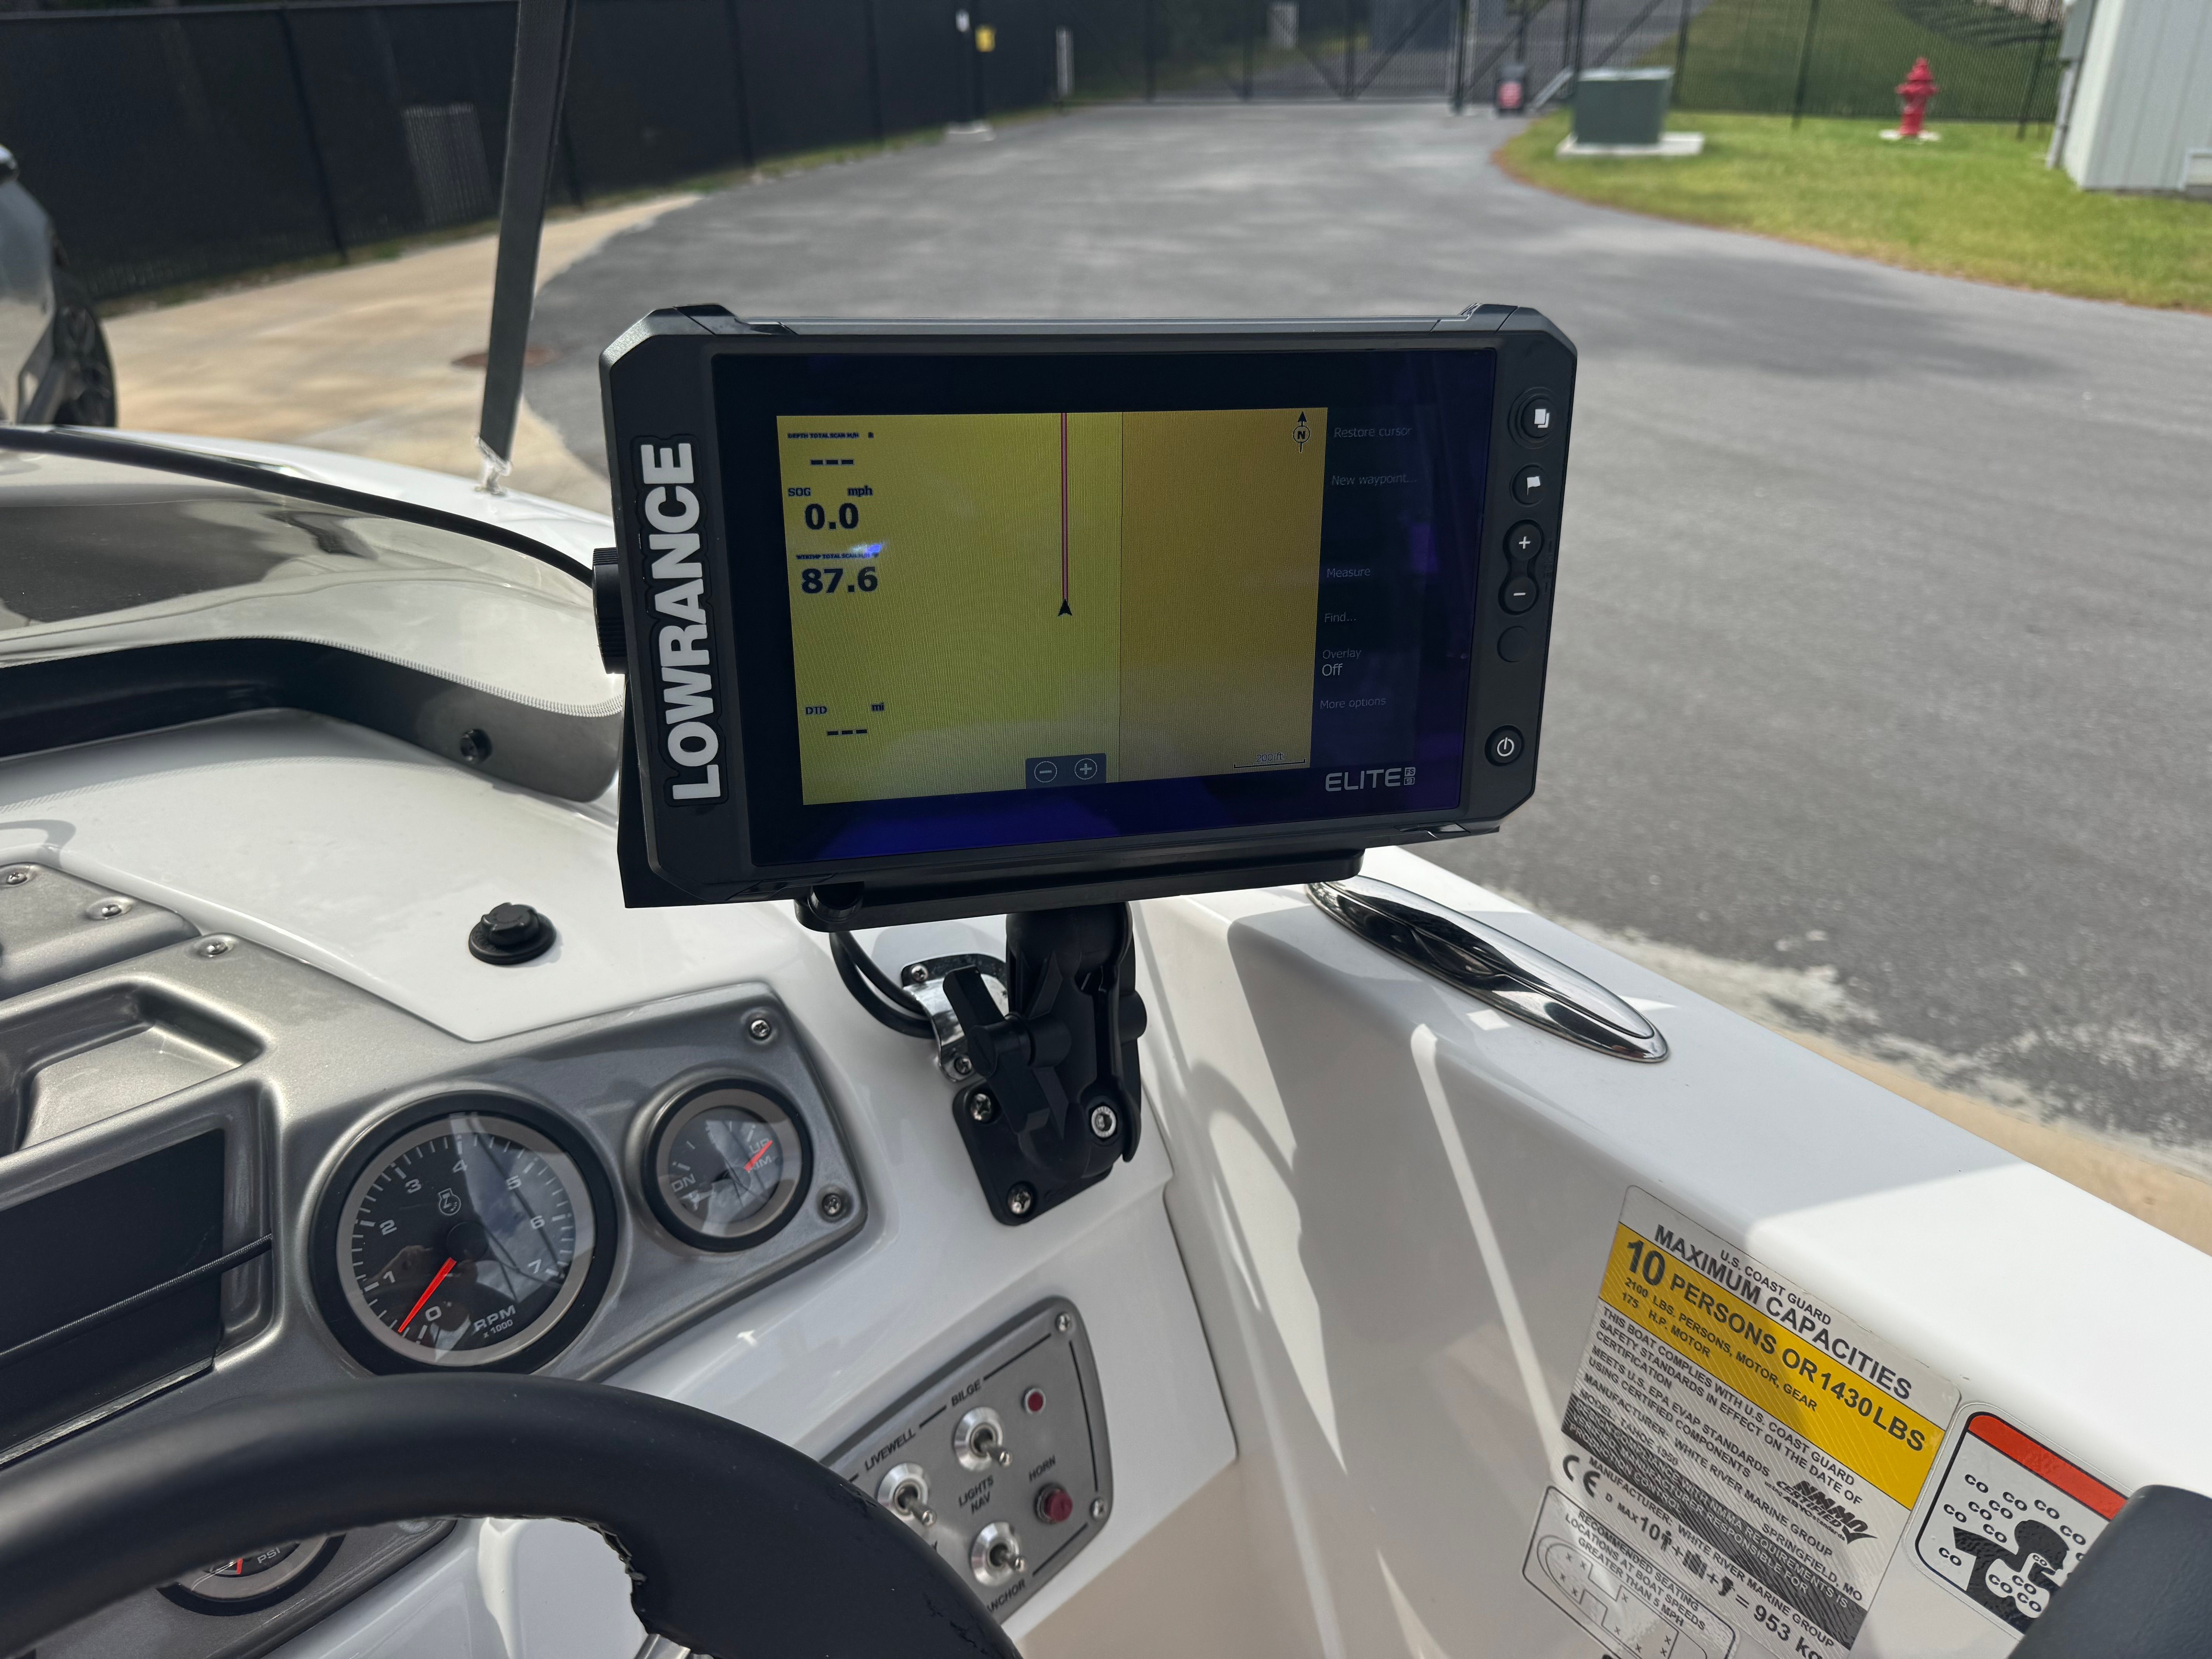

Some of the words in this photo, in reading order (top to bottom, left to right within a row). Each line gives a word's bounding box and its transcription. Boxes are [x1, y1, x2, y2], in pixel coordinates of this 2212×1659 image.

[1334, 428, 1375, 438] Restore
[1379, 427, 1412, 436] cursor
[788, 487, 811, 496] SOG
[848, 484, 873, 497] mph
[1331, 475, 1355, 486] New
[805, 503, 859, 530] 0.0
[802, 566, 878, 594] 87.6
[1327, 568, 1370, 578] Measure
[641, 442, 721, 800] LOWRANCE
[1324, 612, 1356, 623] Find...
[1322, 649, 1362, 659] Overlay
[1322, 663, 1343, 676] Off
[805, 706, 828, 715] DTD
[871, 702, 885, 712] mi
[1320, 700, 1345, 709] More
[1349, 698, 1386, 709] options
[1256, 754, 1273, 763] 200
[1325, 768, 1402, 792] ELITE
[452, 1159, 467, 1174] 4
[405, 1178, 422, 1194] 3
[506, 1175, 522, 1190] 5
[671, 1173, 696, 1192] DN
[380, 1219, 397, 1235] 2
[530, 1215, 545, 1230] 6
[528, 1258, 542, 1274] 7
[383, 1271, 396, 1284] 1
[1719, 1249, 1743, 1270] U.S.
[1744, 1264, 1786, 1297] COAST
[1786, 1291, 1832, 1326] GUARD
[425, 1305, 442, 1322] 0
[473, 1305, 516, 1331] RPM
[1654, 1224, 1761, 1305] MAXIMUM
[1764, 1294, 1913, 1401] CAPACITIES
[490, 1319, 514, 1333] 1000
[1621, 1291, 1639, 1310] 175
[1648, 1309, 1669, 1329] H.P.
[1670, 1324, 1711, 1358] MOTOR
[1624, 1276, 1649, 1299] 2100
[1652, 1295, 1677, 1318] LBS.
[1678, 1312, 1734, 1357] PERSONS,
[1735, 1350, 1781, 1389] MOTOR,
[1782, 1382, 1818, 1412] GEAR
[1627, 1239, 1666, 1286] 10
[1669, 1273, 1778, 1356] PERSONS
[1780, 1345, 1819, 1383] OR
[1817, 1369, 1874, 1419] 1430
[1872, 1406, 1927, 1453] LBS
[1595, 1330, 1672, 1389] CERTIFICATION
[950, 1379, 982, 1407] BILGE
[1602, 1306, 1626, 1329] THIS
[1627, 1324, 1656, 1350] BOAT
[1657, 1345, 1713, 1388] COMPLIES
[1714, 1383, 1742, 1409] WITH
[1743, 1404, 1766, 1425] U.S.
[1767, 1420, 1810, 1455] COAST
[1810, 1449, 1855, 1486] GUARD
[1588, 1356, 1619, 1384] USING
[1620, 1379, 1674, 1423] CERTIFIED
[1674, 1418, 1751, 1478] COMPONENTS
[1591, 1345, 1625, 1375] MEETS
[1626, 1370, 1647, 1390] U.S.
[1648, 1385, 1671, 1407] EPA
[1671, 1401, 1701, 1428] EVAP
[1701, 1423, 1770, 1477] STANDARDS
[1599, 1318, 1638, 1352] SAFETY
[1639, 1346, 1705, 1398] STANDARDS
[1705, 1393, 1717, 1407] IN
[1719, 1402, 1762, 1437] EFFECT
[1763, 1432, 1782, 1451] ON
[1783, 1446, 1808, 1469] THE
[1808, 1464, 1843, 1493] DATE
[1843, 1488, 1863, 1507] OF
[864, 1428, 916, 1471] LIVEWELL
[1029, 1455, 1056, 1482] HORN
[1584, 1372, 1669, 1440] MANUFACTURER:
[1673, 1437, 1709, 1469] WHITE
[1709, 1463, 1743, 1494] RIVER
[1744, 1489, 1789, 1527] MARINE
[1790, 1522, 1833, 1559] GROUP
[958, 1475, 994, 1507] LIGHTS
[1965, 1474, 1988, 1493] CO
[970, 1491, 991, 1514] NAV
[1776, 1478, 1842, 1530] CERTIFIED
[1968, 1501, 1992, 1520] CO
[1989, 1500, 2013, 1519] CO
[2002, 1492, 2027, 1511] CO
[2034, 1499, 2059, 1519] CO
[1944, 1504, 1966, 1522] CO
[1983, 1524, 2007, 1543] CO
[2060, 1525, 2086, 1545] CO
[1589, 1456, 1673, 1527] MANUFACTURER:
[1676, 1523, 1712, 1556] WHITE
[1712, 1551, 1746, 1582] RIVER
[1747, 1577, 1791, 1616] MARINE
[1791, 1611, 1834, 1649] GROUP
[1680, 1479, 1708, 1504] WITH
[1709, 1500, 1743, 1530] NMMA
[1744, 1526, 1835, 1598] REQUIREMENTS
[1836, 1594, 1849, 1609] IS
[1705, 1511, 1783, 1574] RESPONSIBLE
[1784, 1570, 1809, 1594] FOR
[257, 1547, 281, 1564] PSI
[1578, 1511, 1653, 1576] RECOMMENDED
[1654, 1571, 1699, 1613] SEATING
[1760, 1522, 1841, 1587] SPRINGFIELD,
[1842, 1582, 1863, 1602] MO
[1939, 1547, 1961, 1566] CO
[2032, 1554, 2047, 1566] CO
[1565, 1513, 1619, 1562] LOCATIONS
[1620, 1557, 1635, 1575] AT
[1635, 1569, 1664, 1598] BOAT
[1664, 1592, 1706, 1631] SPEEDS
[1578, 1536, 1623, 1578] GREATER
[1625, 1574, 1652, 1601] THAN
[1653, 1597, 1660, 1607] 5
[1661, 1603, 1684, 1627] MPH
[1617, 1502, 1638, 1524] MAX
[1640, 1516, 1661, 1541] 10
[1753, 1604, 1791, 1642] 953
[1989, 1574, 2013, 1593] CO
[2012, 1575, 2037, 1595] CO
[2017, 1592, 2042, 1612] CO
